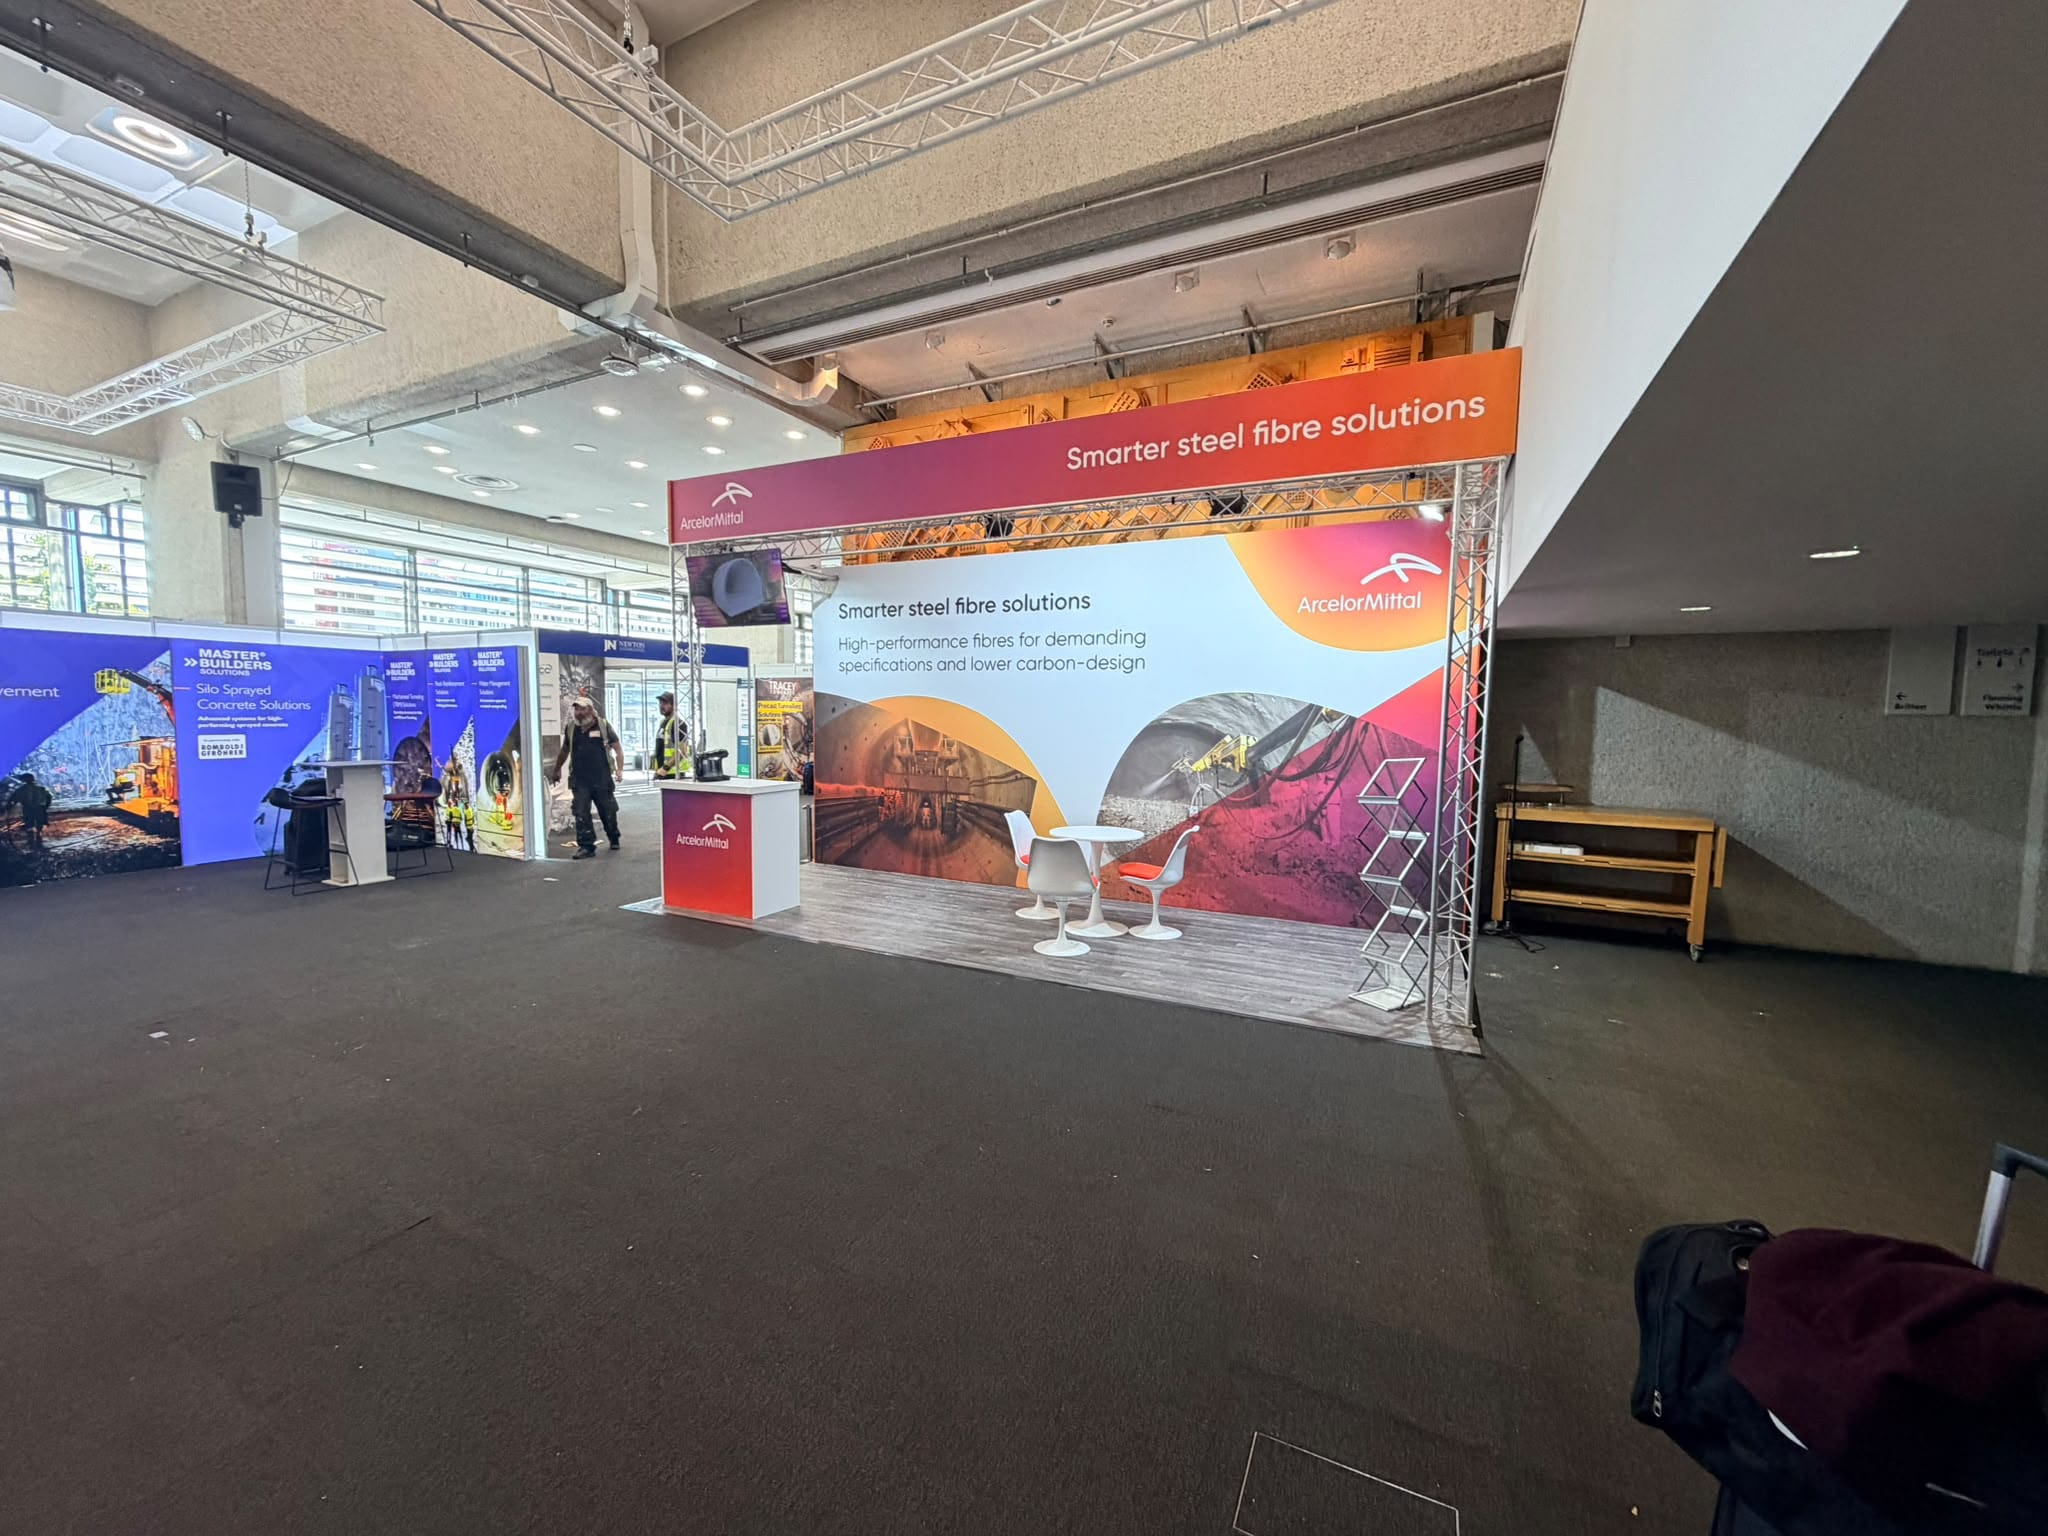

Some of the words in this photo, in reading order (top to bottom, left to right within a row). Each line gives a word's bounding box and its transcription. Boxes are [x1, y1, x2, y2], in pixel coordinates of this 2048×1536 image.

[1066, 441, 1170, 471] Smarter
[1176, 423, 1244, 458] steel
[1253, 417, 1322, 447] fibre
[1330, 394, 1486, 437] solutions
[680, 510, 744, 530] ArcelorMittal
[838, 602, 904, 620] Smarter
[908, 598, 950, 617] steel
[955, 596, 997, 615] fibre
[1001, 593, 1091, 613] solutions
[1297, 591, 1422, 614] ArcelorMittal
[838, 635, 969, 654] High-performance
[972, 632, 1014, 649] fibres
[1019, 632, 1041, 648] for
[1045, 629, 1147, 649] demanding
[199, 649, 260, 660] MASTER
[200, 659, 272, 670] BUILDERS
[838, 657, 933, 675] specifications
[937, 656, 967, 672] and
[970, 656, 1012, 671] lower
[1016, 654, 1146, 675] carbon-design
[196, 683, 219, 695] Silo
[223, 684, 271, 697] Sprayed
[769, 680, 797, 690] TRACEY
[197, 699, 257, 710] Concrete
[260, 700, 311, 710] Solutions
[676, 833, 729, 850] ArcelorMittal
